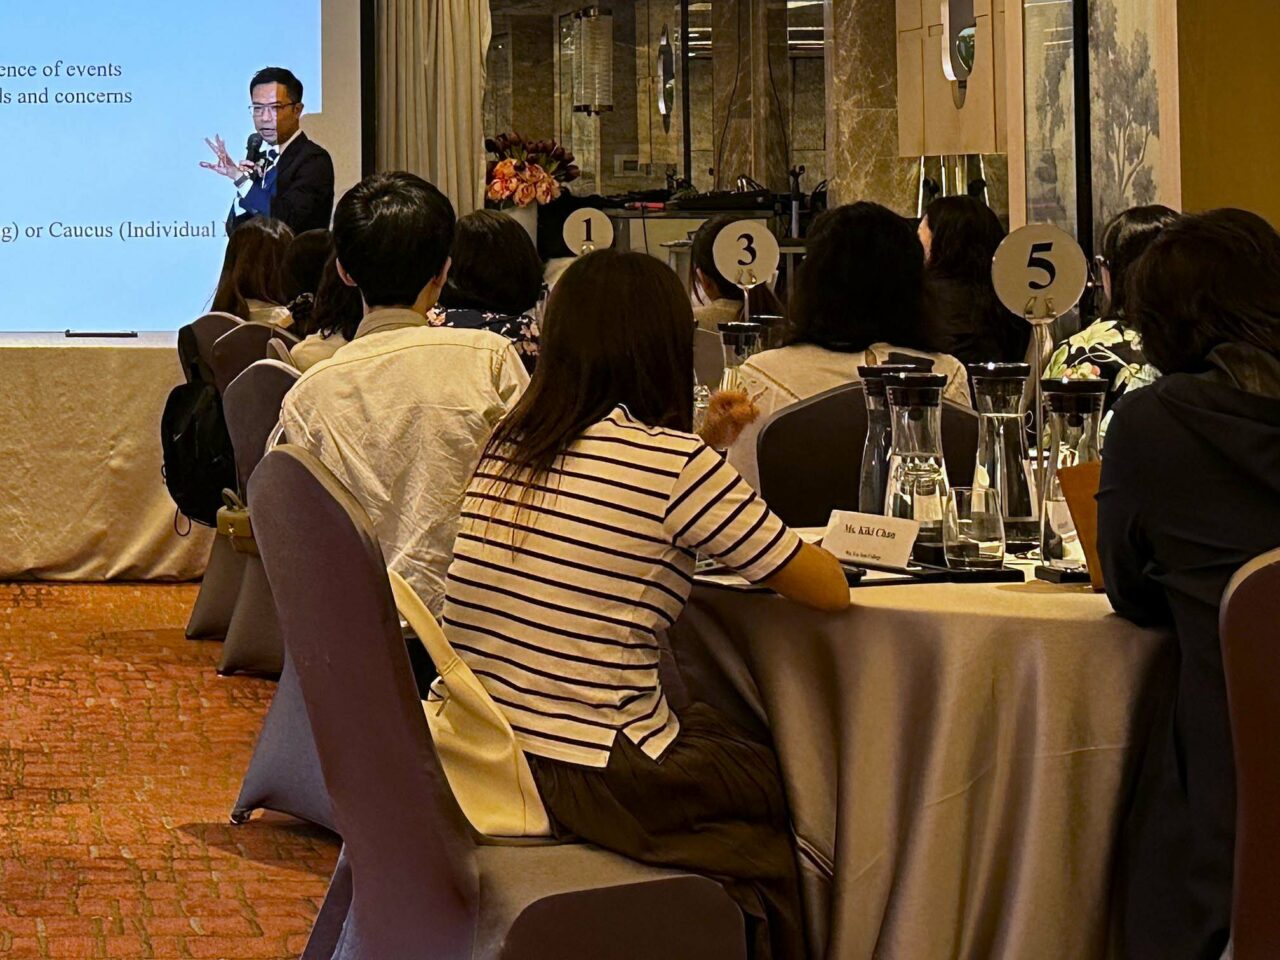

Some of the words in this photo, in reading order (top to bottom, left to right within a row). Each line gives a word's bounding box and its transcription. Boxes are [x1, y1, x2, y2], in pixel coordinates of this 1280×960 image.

[42, 59, 61, 78] of
[65, 61, 122, 79] events
[16, 86, 48, 105] and
[54, 90, 132, 104] concerns
[24, 226, 43, 239] or
[48, 221, 113, 238] Caucus
[118, 219, 216, 243] (Individual
[582, 217, 594, 241] 1
[736, 233, 756, 266] 3
[1027, 241, 1055, 289] 5
